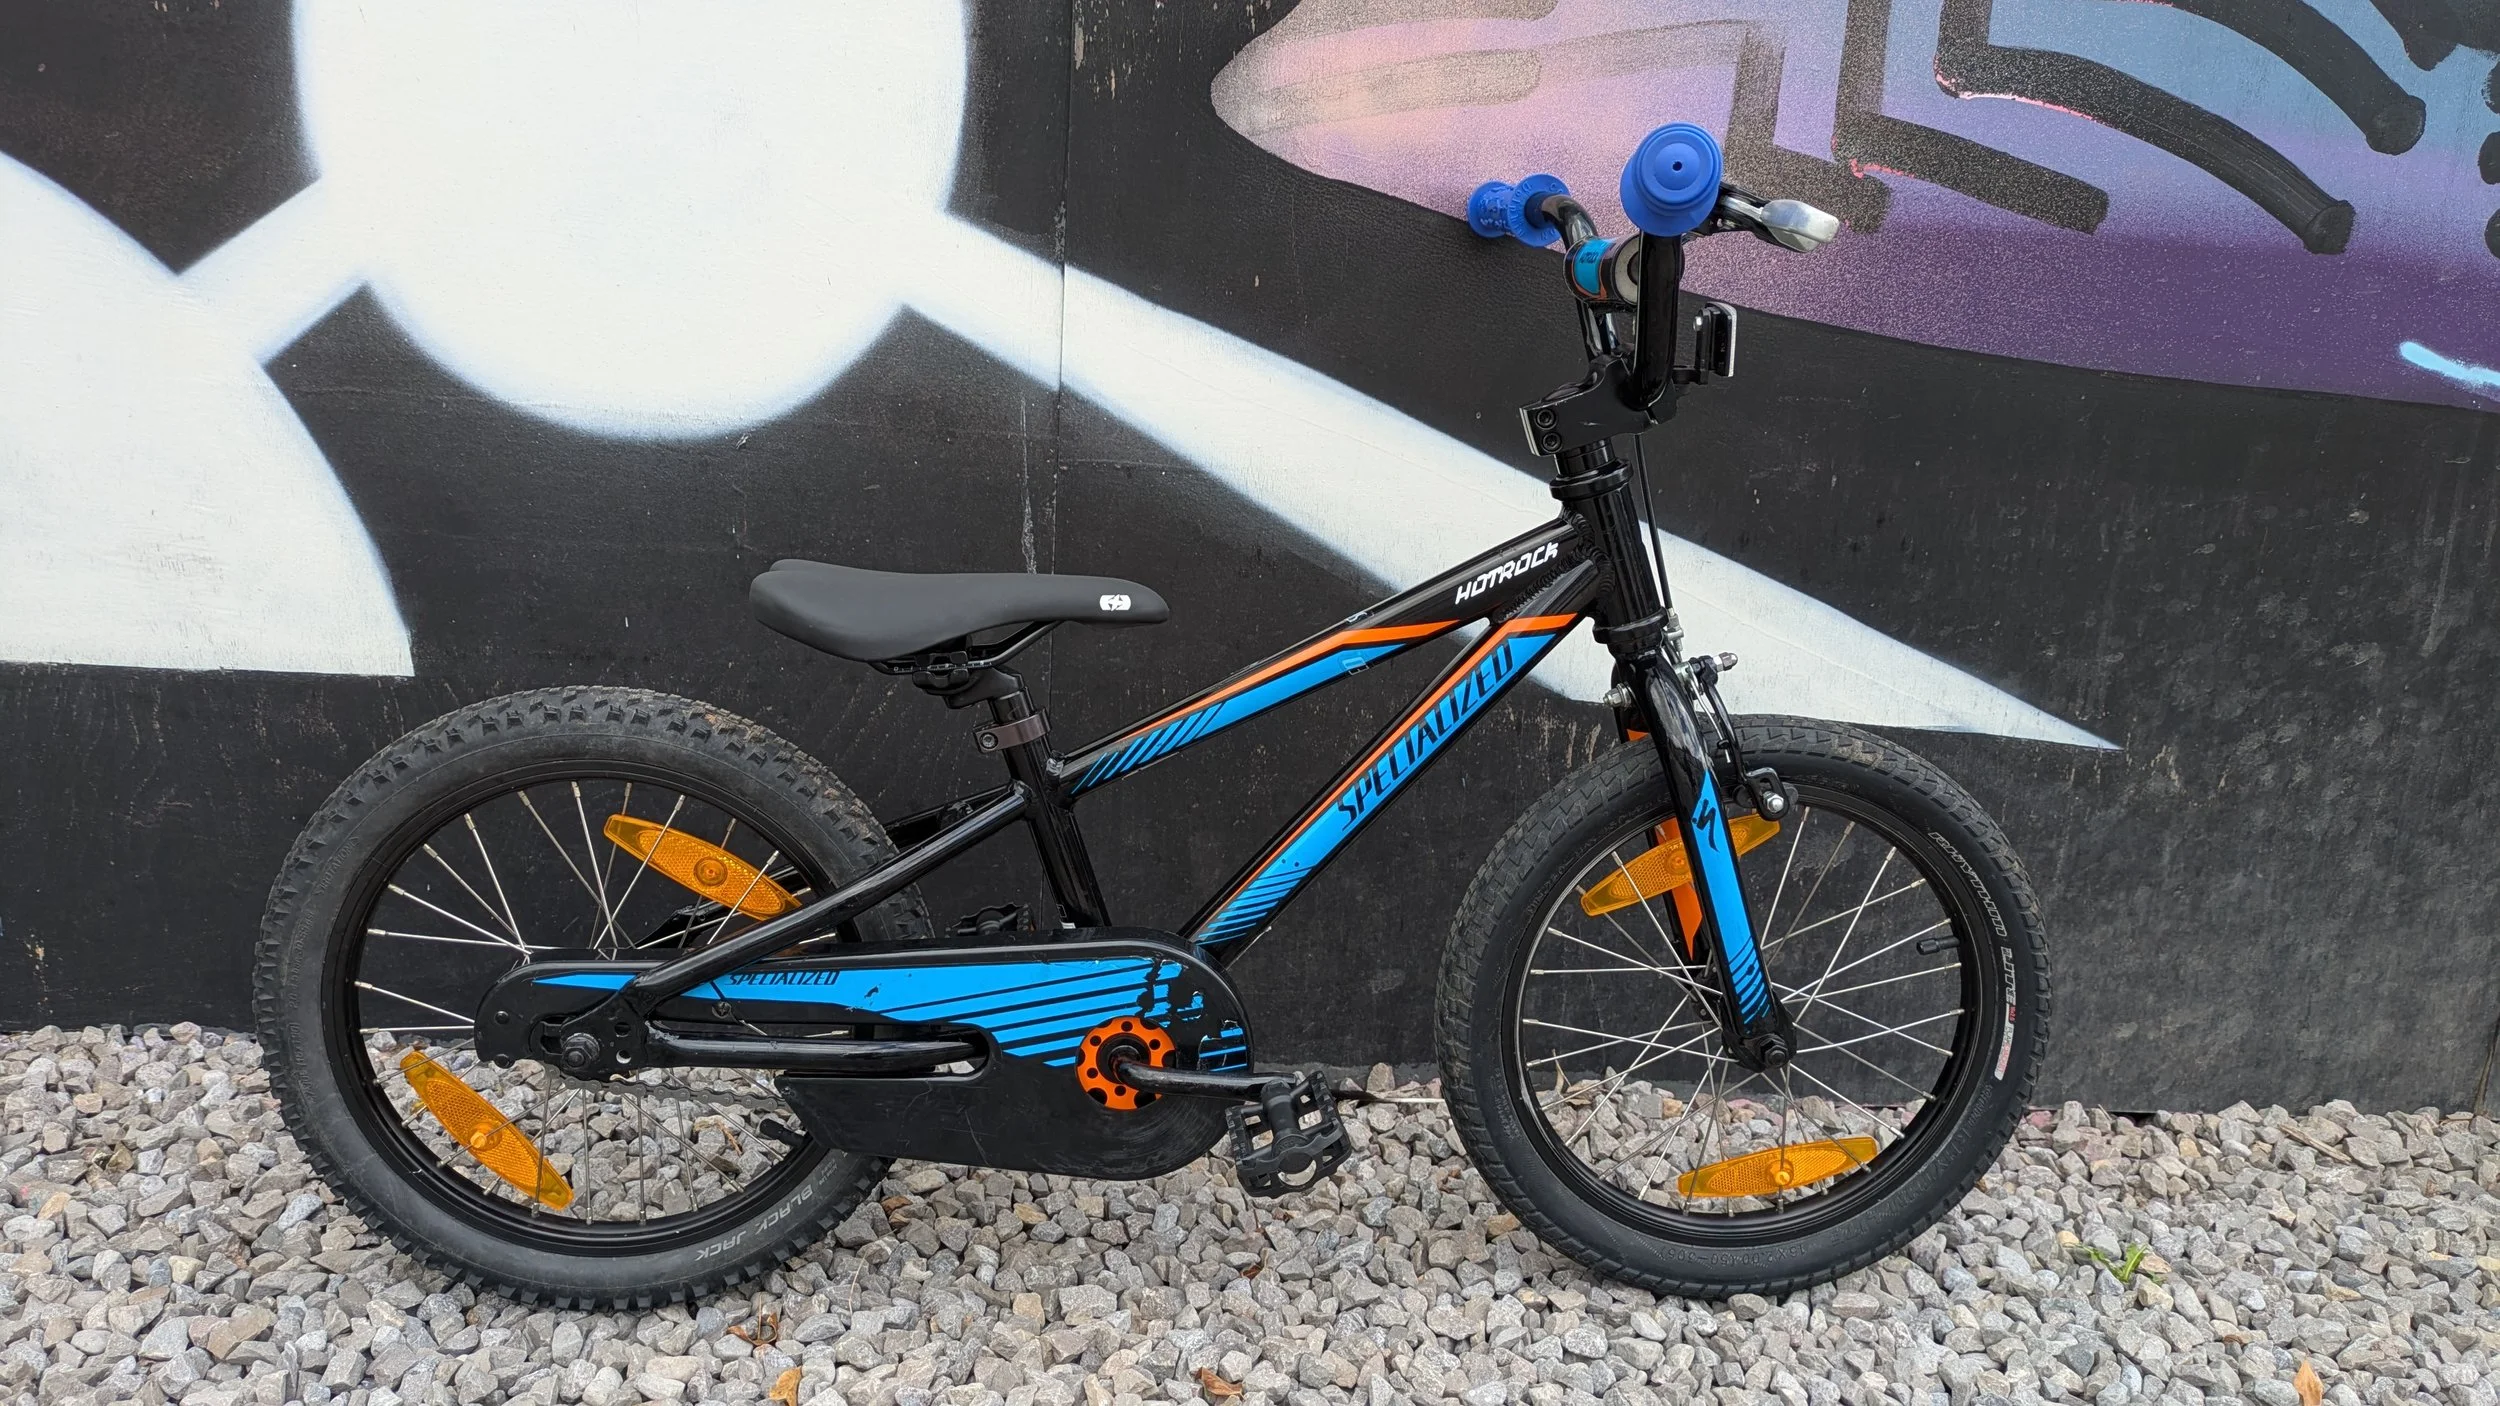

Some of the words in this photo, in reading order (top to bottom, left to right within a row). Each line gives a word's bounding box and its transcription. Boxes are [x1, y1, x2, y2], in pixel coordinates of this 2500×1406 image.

[1455, 542, 1559, 605] HOTROCK
[1337, 641, 1515, 831] SPECIALIZED
[1928, 831, 2008, 937] RHYTHM
[2001, 946, 2017, 1005] LITE
[725, 970, 840, 986] SPECIALIZED
[755, 1184, 813, 1235] BLACK
[694, 1230, 747, 1262] JACK
